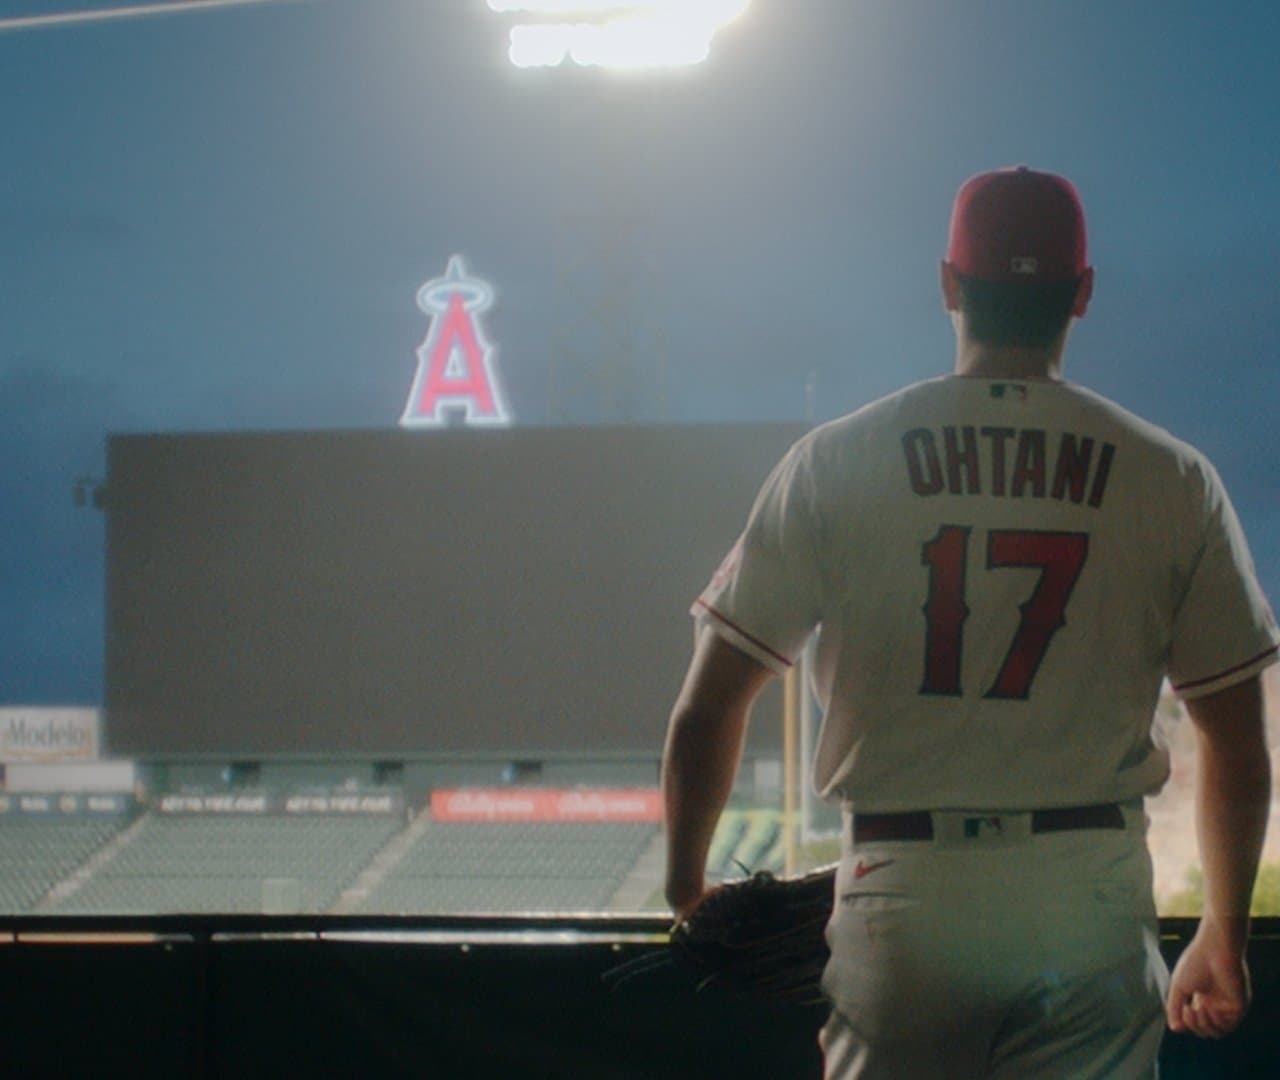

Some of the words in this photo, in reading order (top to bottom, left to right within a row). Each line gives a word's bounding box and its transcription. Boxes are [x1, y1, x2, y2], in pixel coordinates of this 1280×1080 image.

[901, 425, 1115, 508] OHTANI
[919, 524, 1089, 699] 17
[4, 716, 91, 747] Modelo
